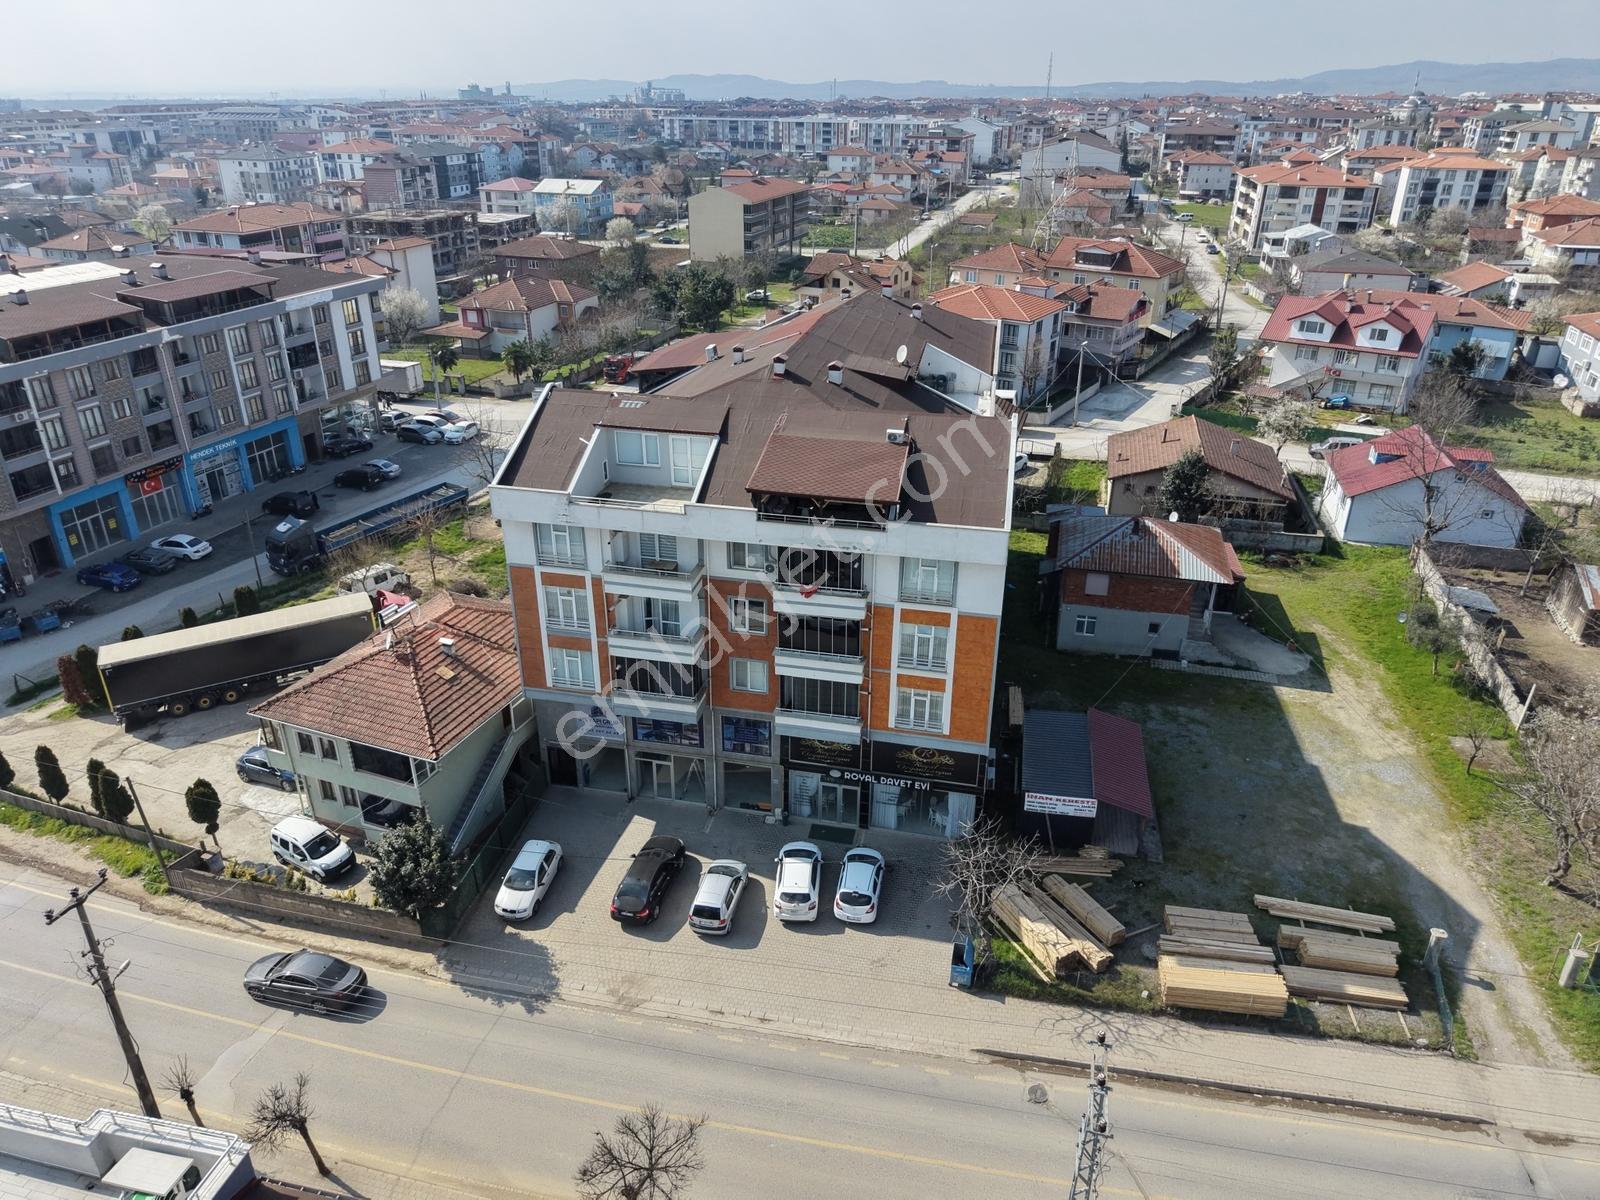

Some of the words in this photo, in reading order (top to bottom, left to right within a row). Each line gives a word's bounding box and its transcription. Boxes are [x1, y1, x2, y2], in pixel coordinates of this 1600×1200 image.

[844, 771, 878, 784] ROYAL
[880, 776, 912, 789] DAVET
[914, 780, 930, 791] EVİ
